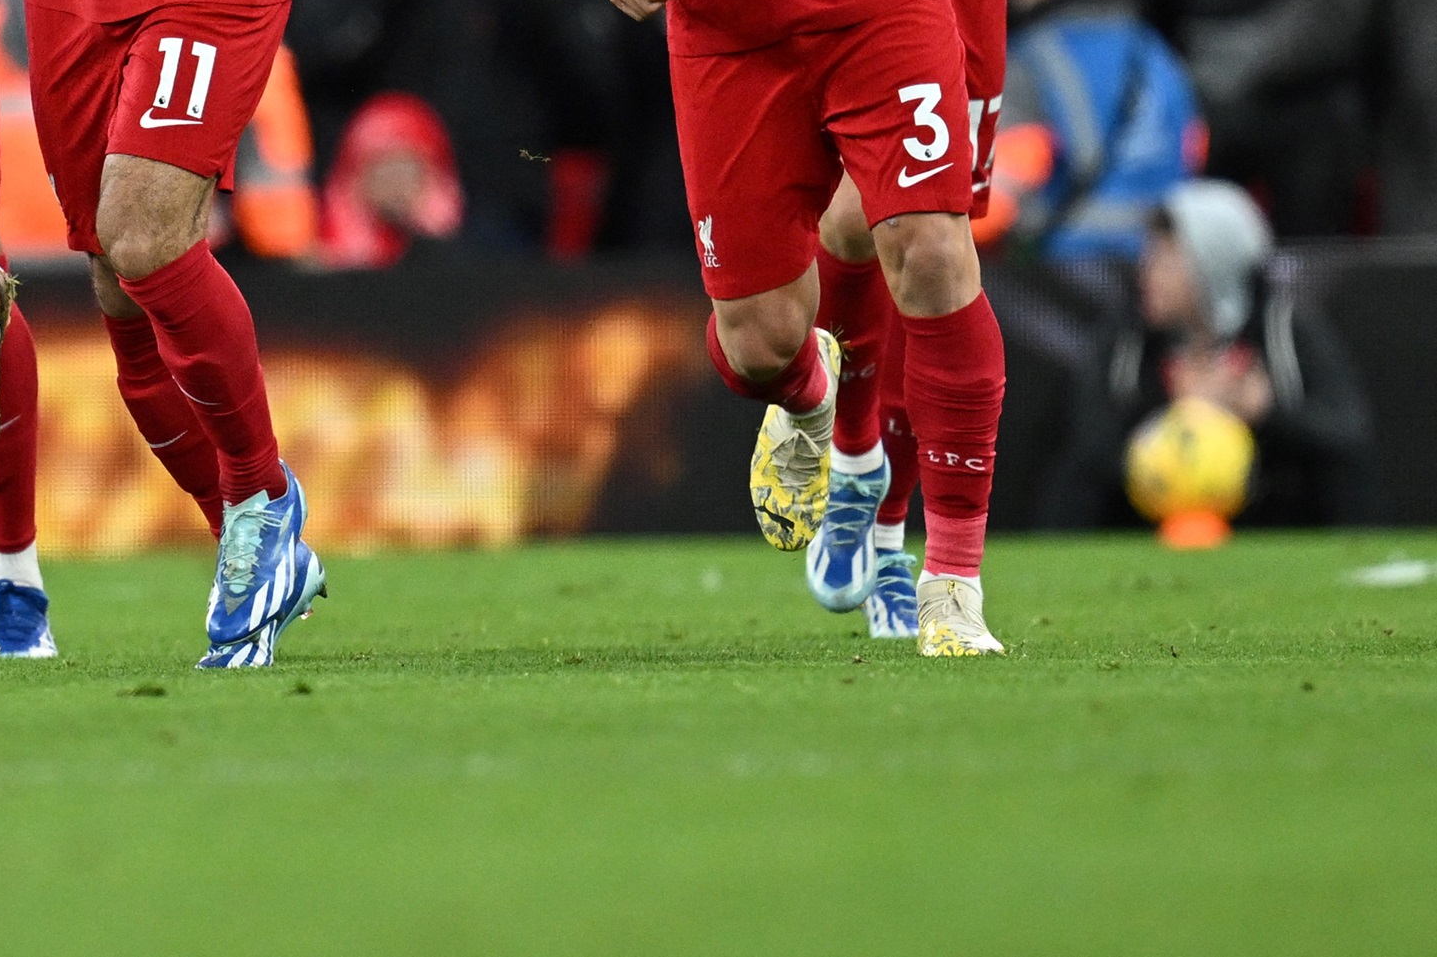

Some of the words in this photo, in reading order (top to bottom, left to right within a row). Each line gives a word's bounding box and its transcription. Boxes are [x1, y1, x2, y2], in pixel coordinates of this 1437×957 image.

[154, 37, 218, 119] 11
[897, 82, 951, 162] 3
[927, 450, 986, 471] LFC
